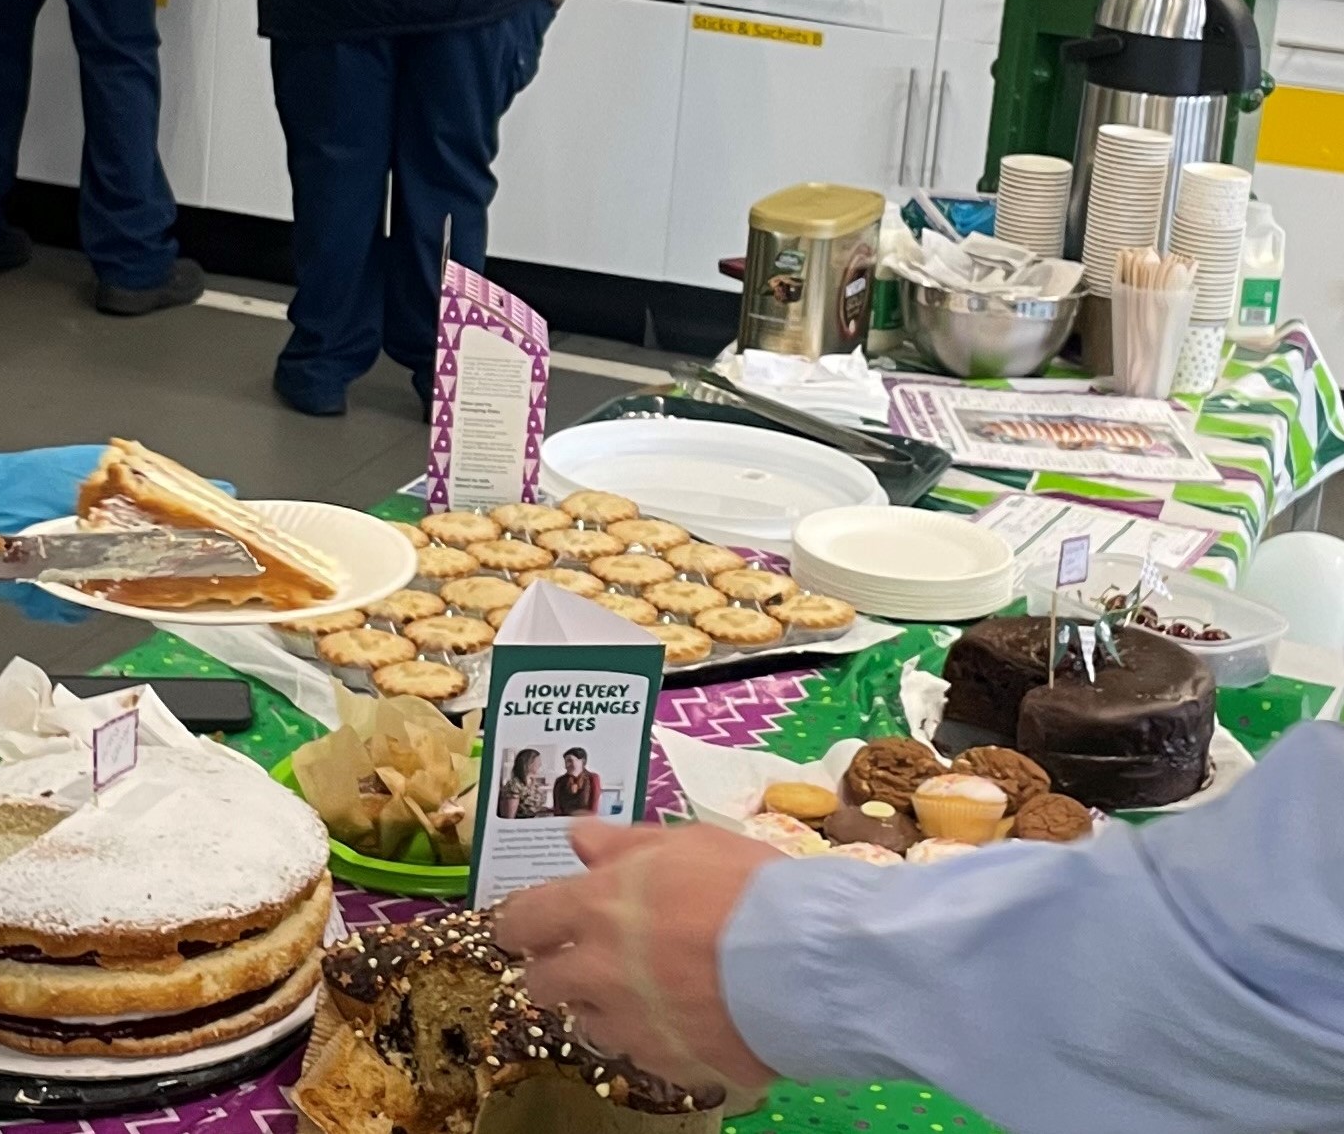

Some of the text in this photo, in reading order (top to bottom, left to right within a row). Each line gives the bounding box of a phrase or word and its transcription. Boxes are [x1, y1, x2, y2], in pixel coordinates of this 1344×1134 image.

[525, 683, 630, 698] HOW EVERY
[503, 700, 641, 716] SLICE CHANGES
[544, 717, 596, 732] LIVES
